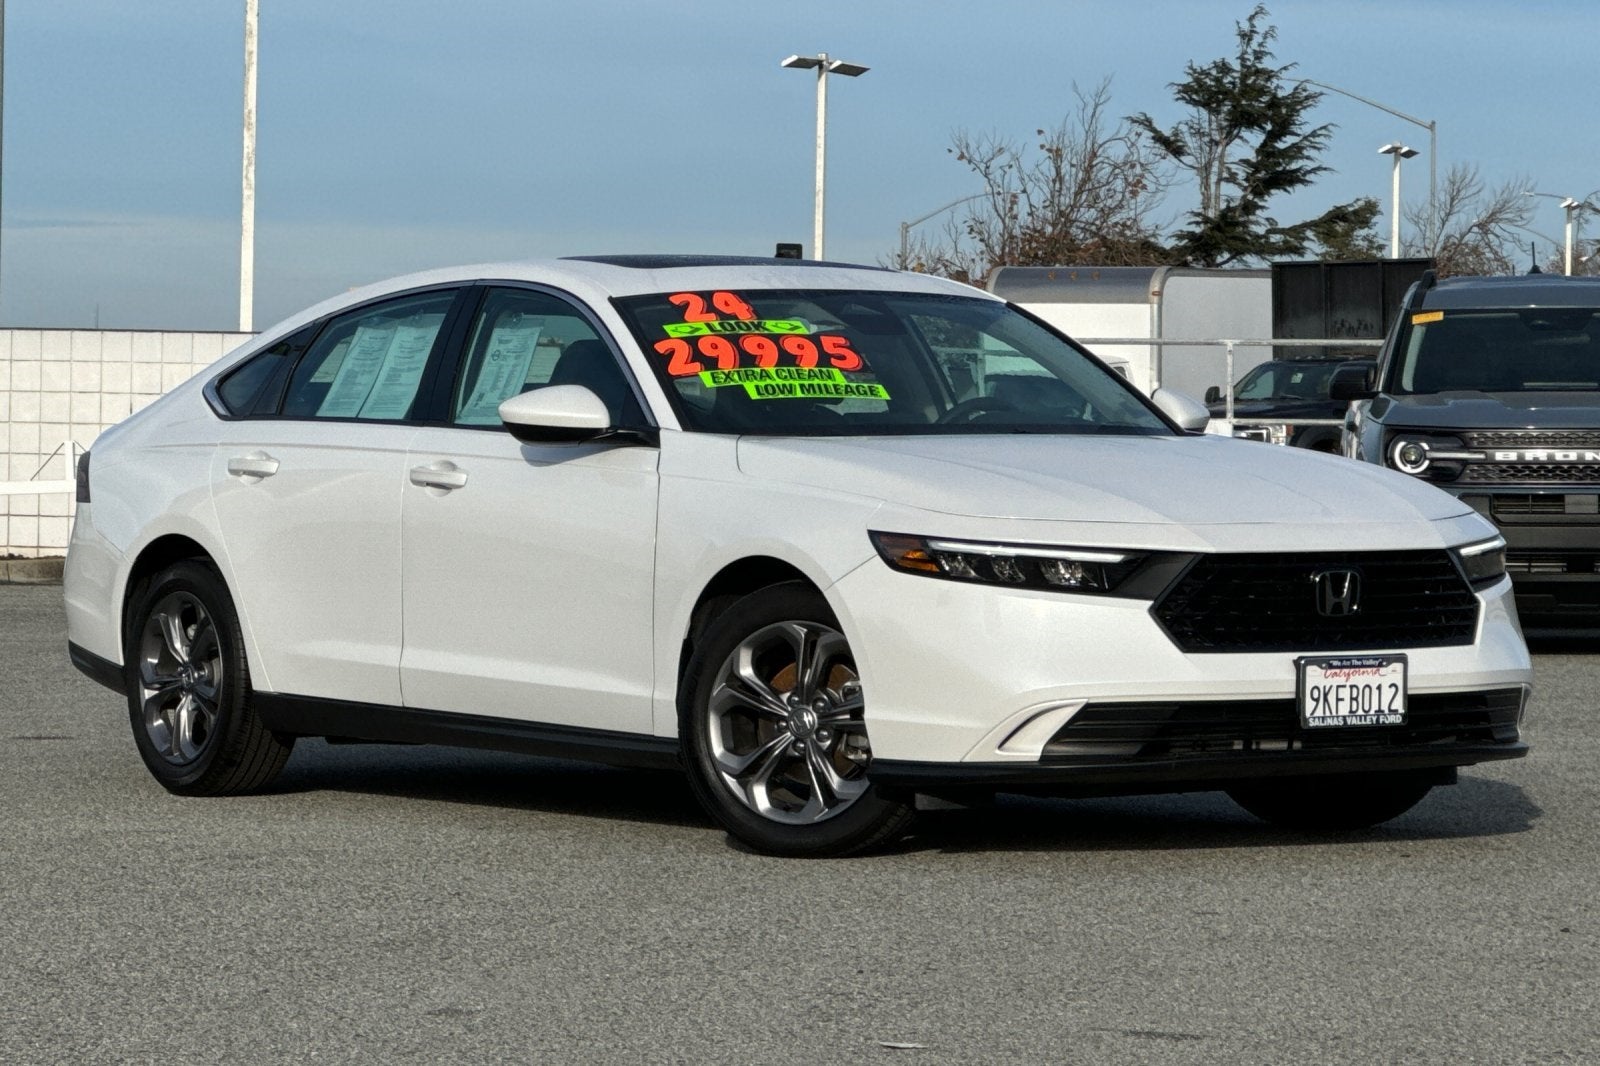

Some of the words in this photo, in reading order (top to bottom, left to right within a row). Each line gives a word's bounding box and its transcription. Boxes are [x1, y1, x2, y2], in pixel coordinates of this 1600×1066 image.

[669, 292, 756, 321] 24
[703, 321, 769, 334] LOOK
[653, 335, 863, 376] 29995
[709, 368, 774, 384] EXTRA
[775, 368, 835, 383] CLEAN
[754, 384, 795, 397] LOW
[799, 384, 881, 397] MILEAGE
[1324, 668, 1387, 682] California
[1310, 683, 1399, 715] 9KFB012
[1308, 716, 1344, 727] SALINAS
[1346, 714, 1377, 725] VALLEY
[1379, 714, 1402, 723] FORD
